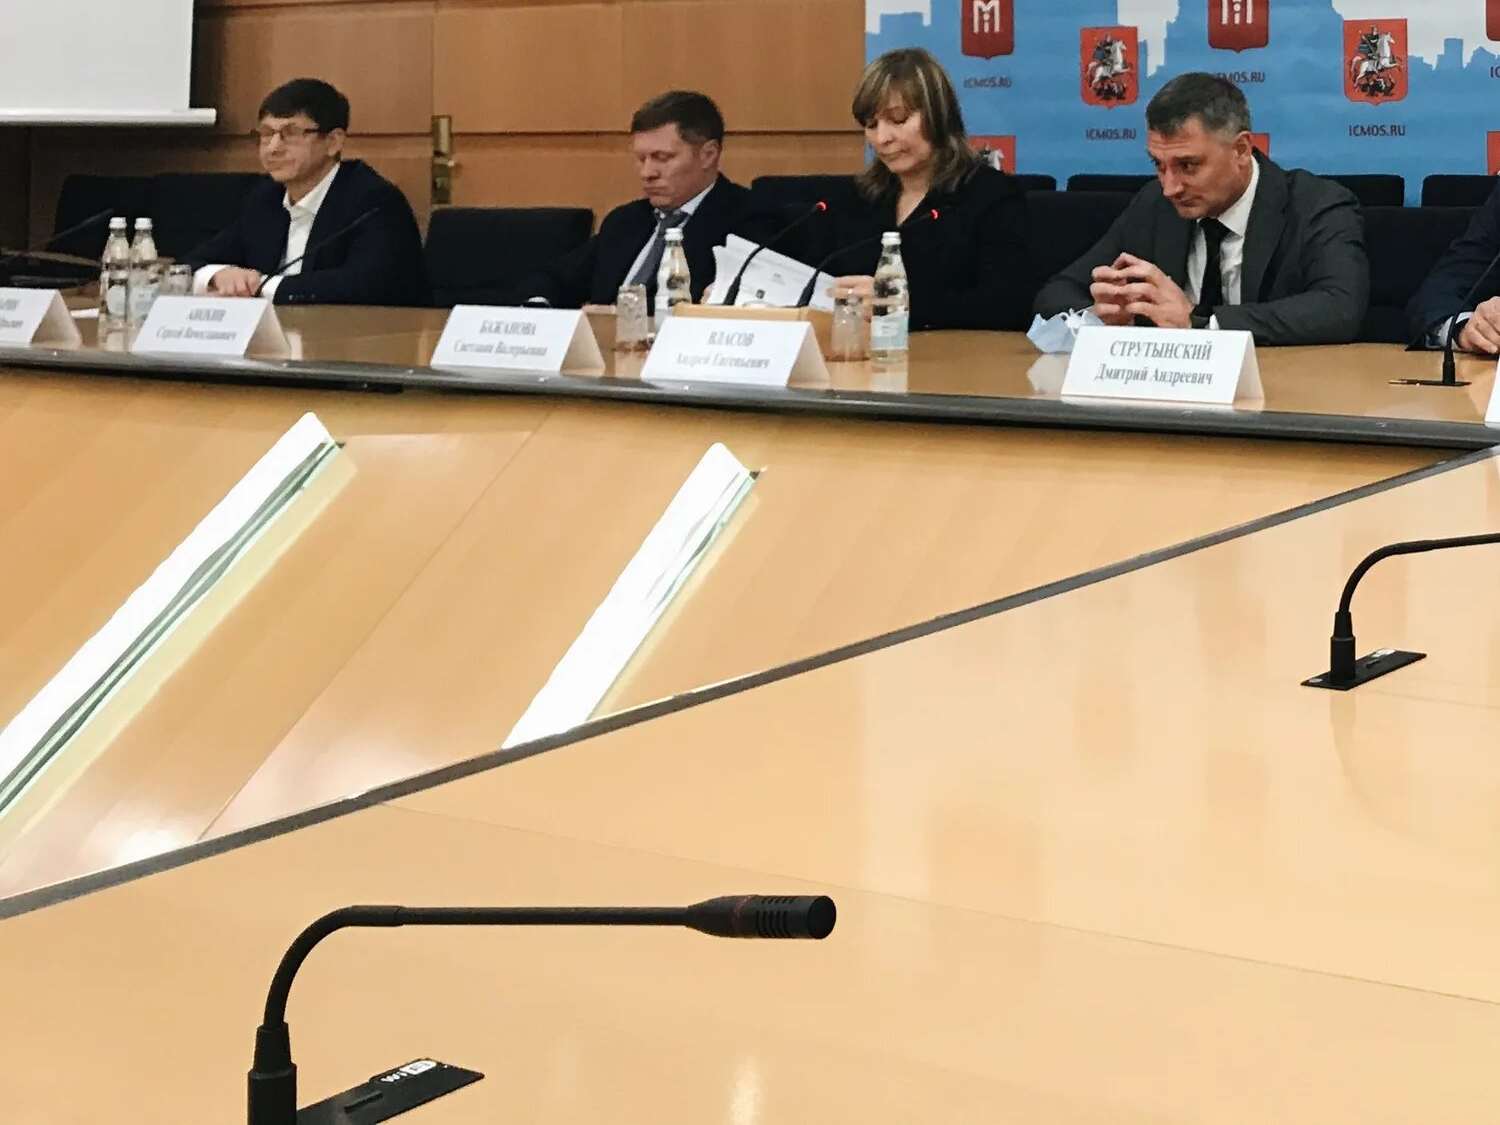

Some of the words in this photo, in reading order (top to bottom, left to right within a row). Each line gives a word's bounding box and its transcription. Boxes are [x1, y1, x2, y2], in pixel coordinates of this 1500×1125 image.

[964, 76, 1012, 88] ICMOS.RU
[1217, 71, 1266, 84] MOS.RU
[1086, 128, 1136, 140] ICMOS.RU
[1348, 123, 1406, 137] ICMOS.RU
[707, 331, 755, 347] ВЛАСОВ
[1110, 340, 1213, 361] СТРУТЫНСКИЙ
[1094, 363, 1149, 386] Дмитрий
[1150, 367, 1213, 387] Андреевич
